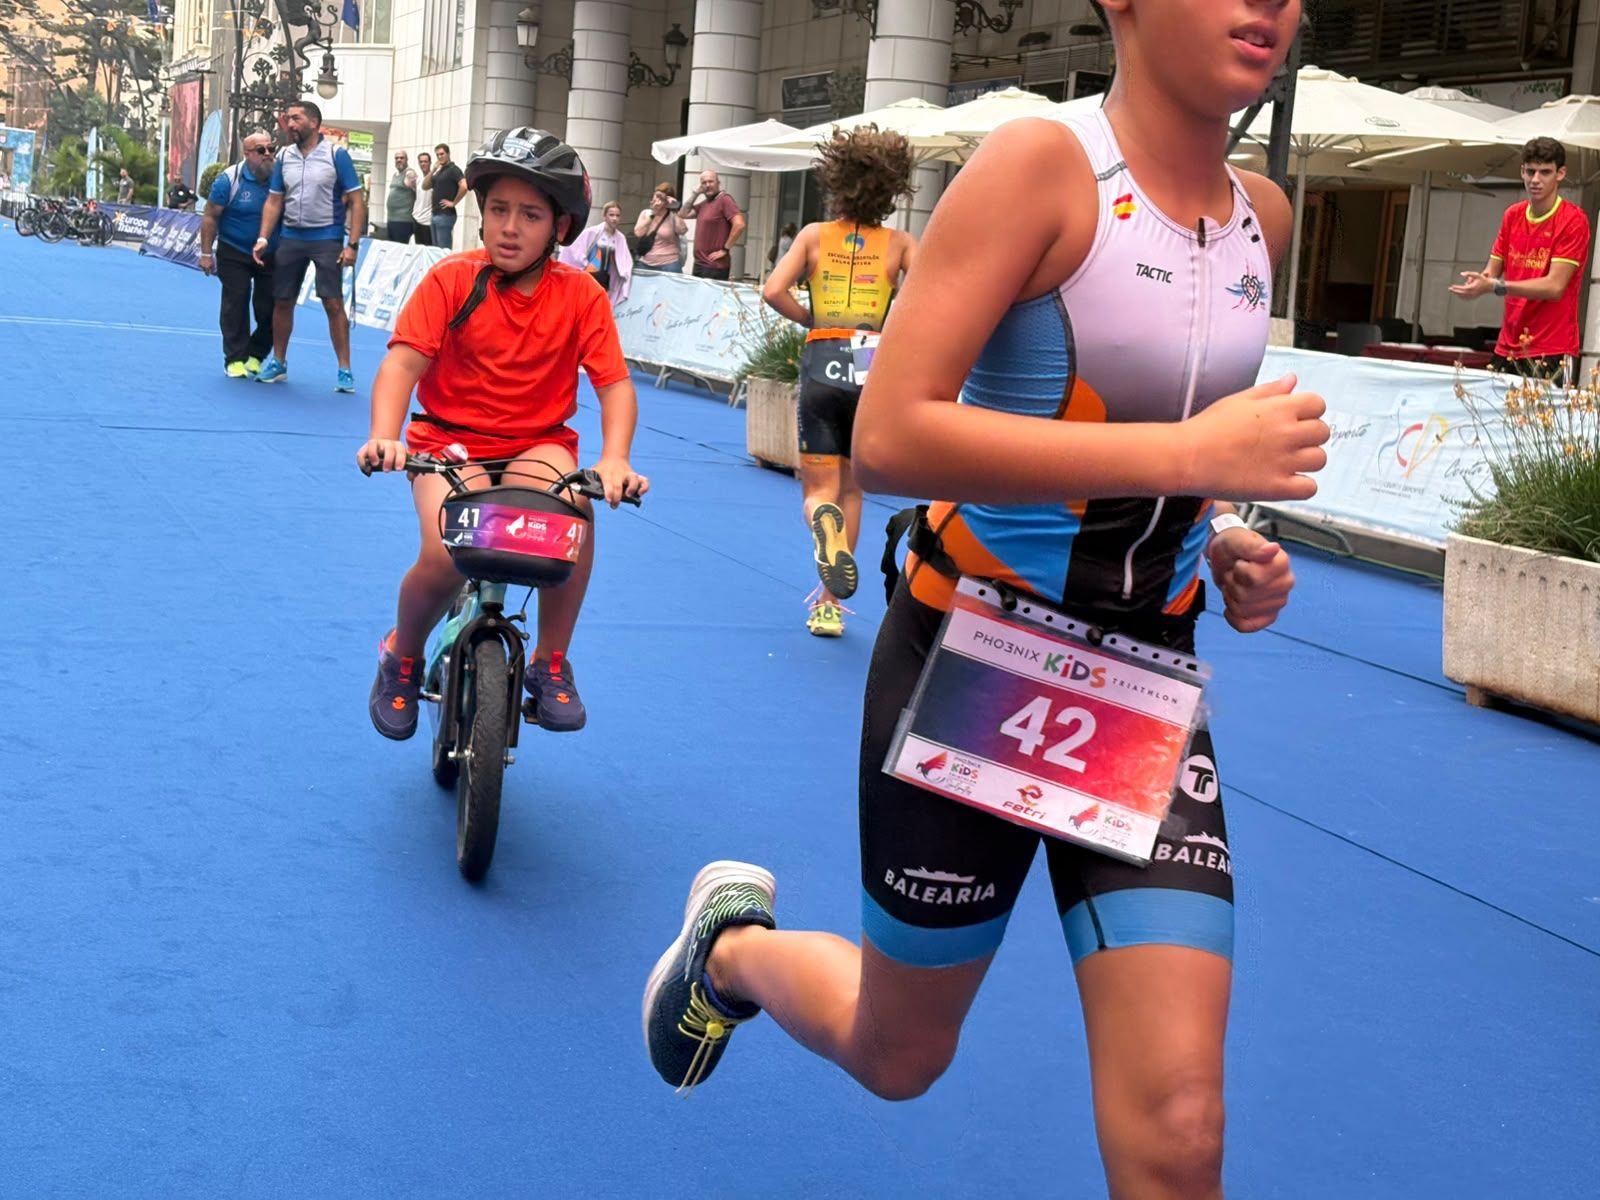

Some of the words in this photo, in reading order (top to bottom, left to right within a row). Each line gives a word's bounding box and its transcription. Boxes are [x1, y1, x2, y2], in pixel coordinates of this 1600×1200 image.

[121, 213, 149, 228] Europe
[1136, 263, 1173, 284] TACTIC
[458, 507, 480, 528] 41
[566, 522, 583, 544] 41
[1042, 653, 1107, 689] KiDS
[1112, 677, 1178, 705] TRIATHLON
[1000, 695, 1097, 774] 42
[951, 763, 979, 780] KiDS
[1154, 842, 1232, 876] BALEA
